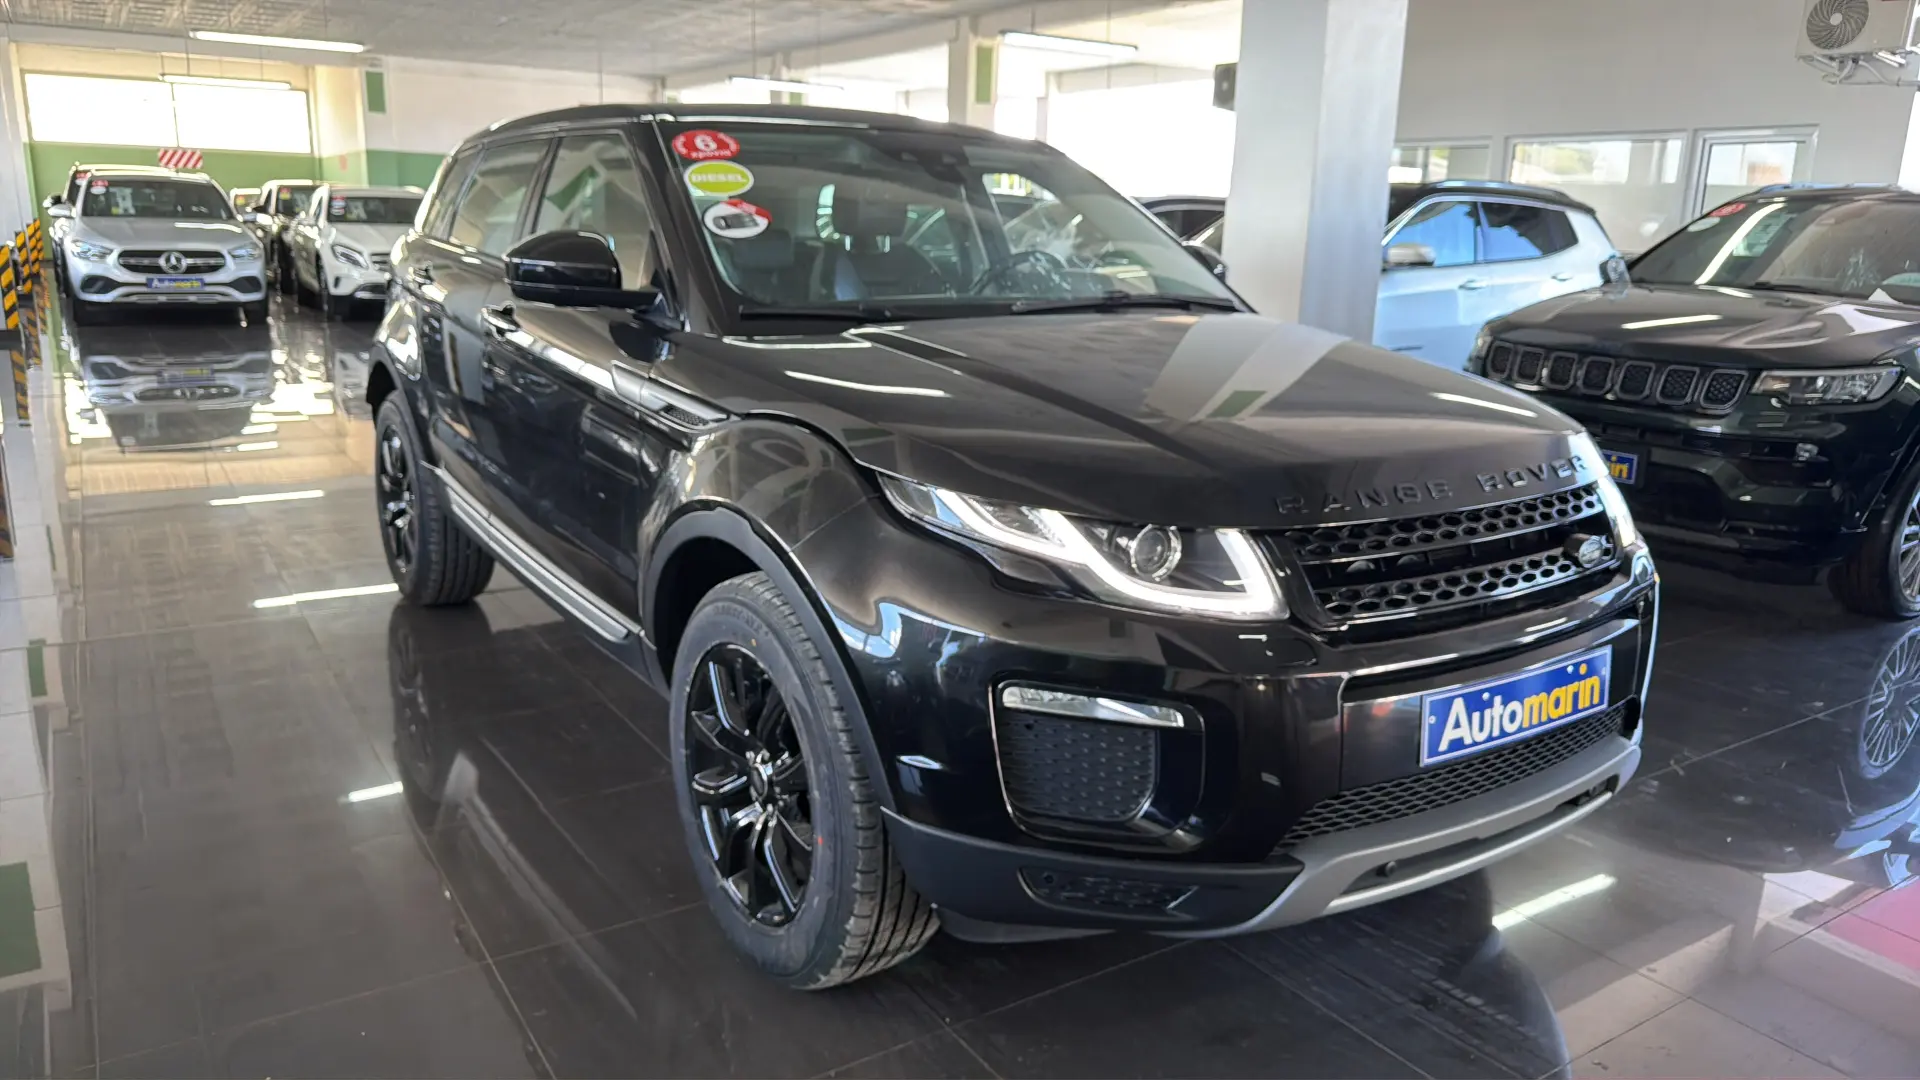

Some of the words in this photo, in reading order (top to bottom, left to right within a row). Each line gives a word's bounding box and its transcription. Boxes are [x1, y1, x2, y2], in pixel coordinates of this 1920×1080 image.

[691, 173, 746, 183] DIESEL
[1276, 479, 1453, 513] RANGE
[1476, 455, 1588, 493] ROVER
[1437, 663, 1600, 752] Automarin
